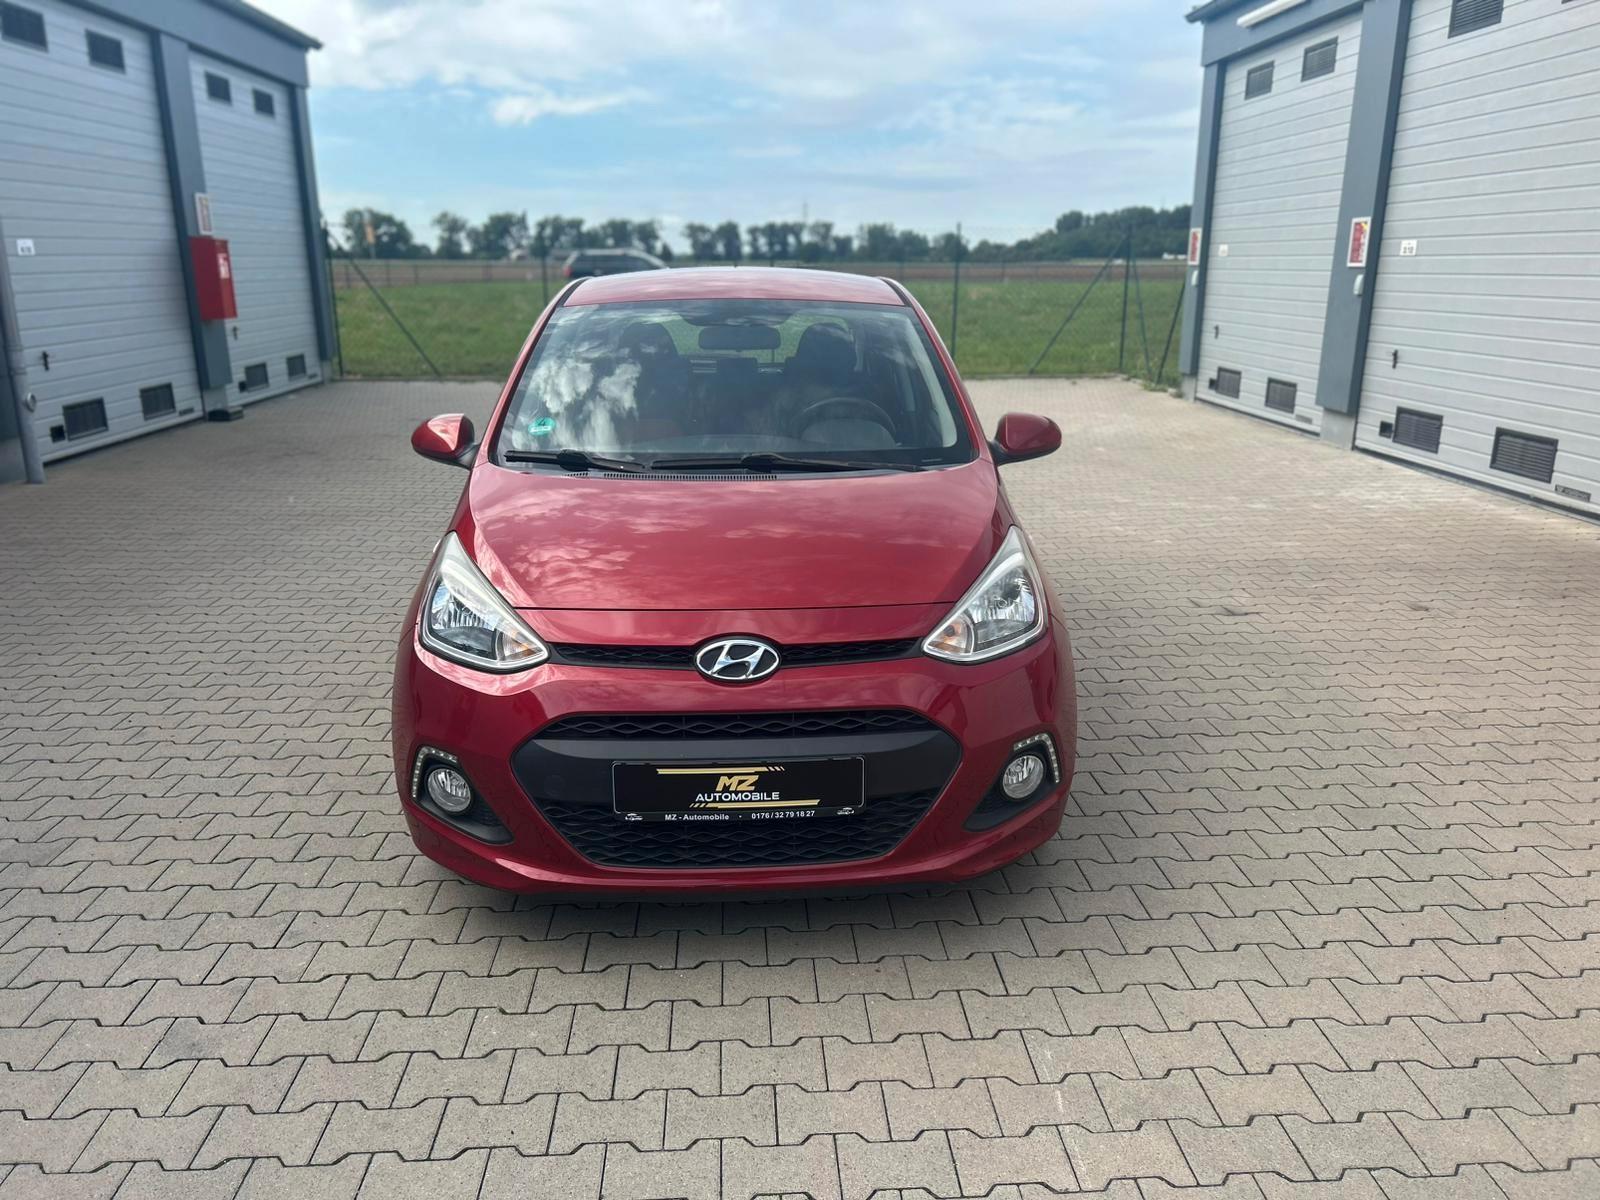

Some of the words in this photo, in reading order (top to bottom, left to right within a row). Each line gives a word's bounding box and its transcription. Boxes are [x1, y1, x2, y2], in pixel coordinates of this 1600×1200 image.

[715, 775, 759, 791] MZ
[695, 792, 780, 802] AUTOMOBILE
[683, 813, 730, 821] Automobile
